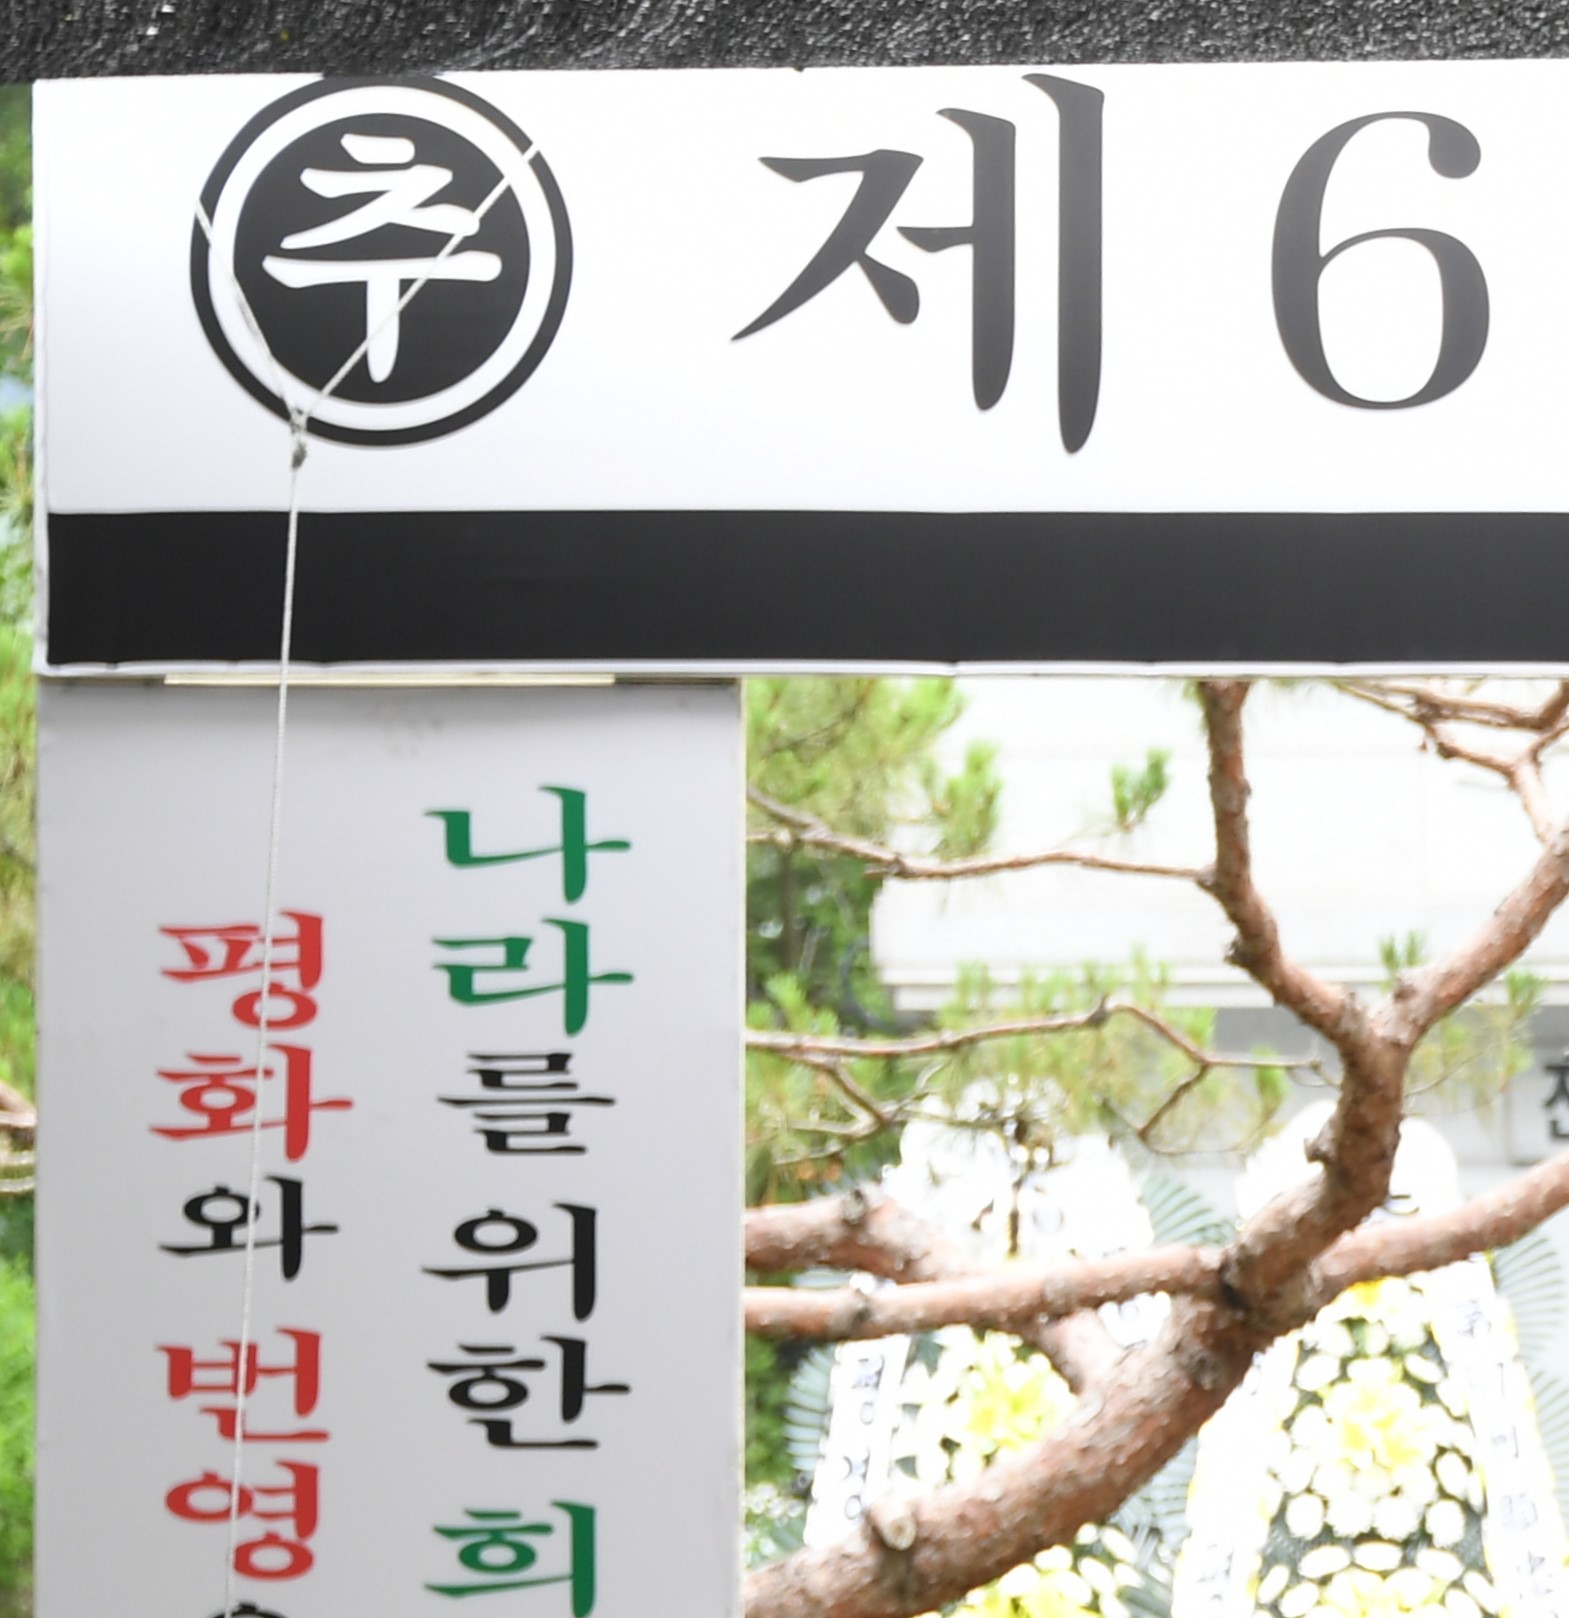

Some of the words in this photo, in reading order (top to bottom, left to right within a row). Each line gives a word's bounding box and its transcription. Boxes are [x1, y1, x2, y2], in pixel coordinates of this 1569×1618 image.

[152, 912, 352, 1281] 평화와
[429, 787, 632, 1154] 나라를
[425, 1204, 629, 1448] 위한
